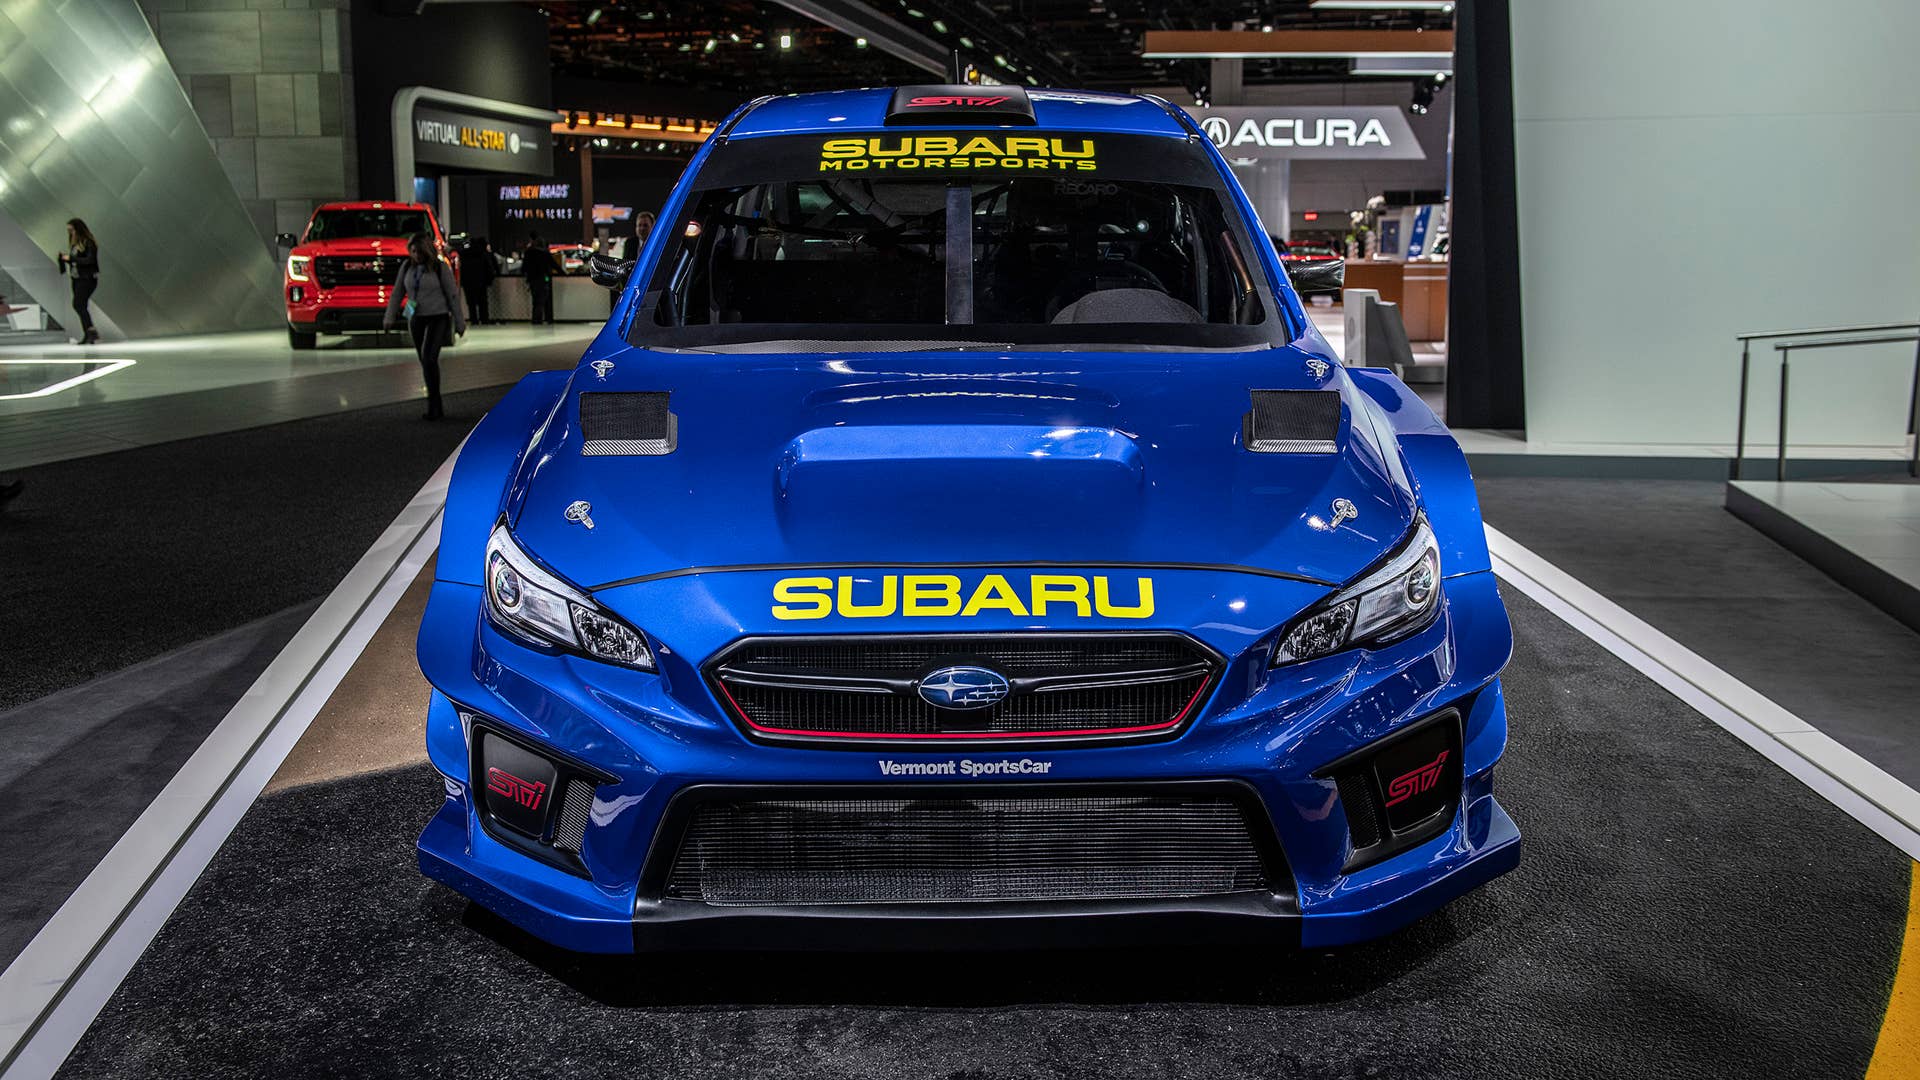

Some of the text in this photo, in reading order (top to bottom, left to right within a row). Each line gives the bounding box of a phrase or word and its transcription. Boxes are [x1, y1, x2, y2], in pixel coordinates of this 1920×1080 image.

[417, 120, 460, 146] VIRTUAL
[461, 127, 505, 150] ALL-STAR
[1231, 118, 1391, 147] ACURA
[821, 136, 1096, 159] SUBARU
[819, 157, 1097, 172] MOTORSPORTS
[1055, 183, 1119, 196] RECARO
[771, 574, 1155, 621] SUBARU
[879, 759, 1052, 777] Vermont SportsCar
